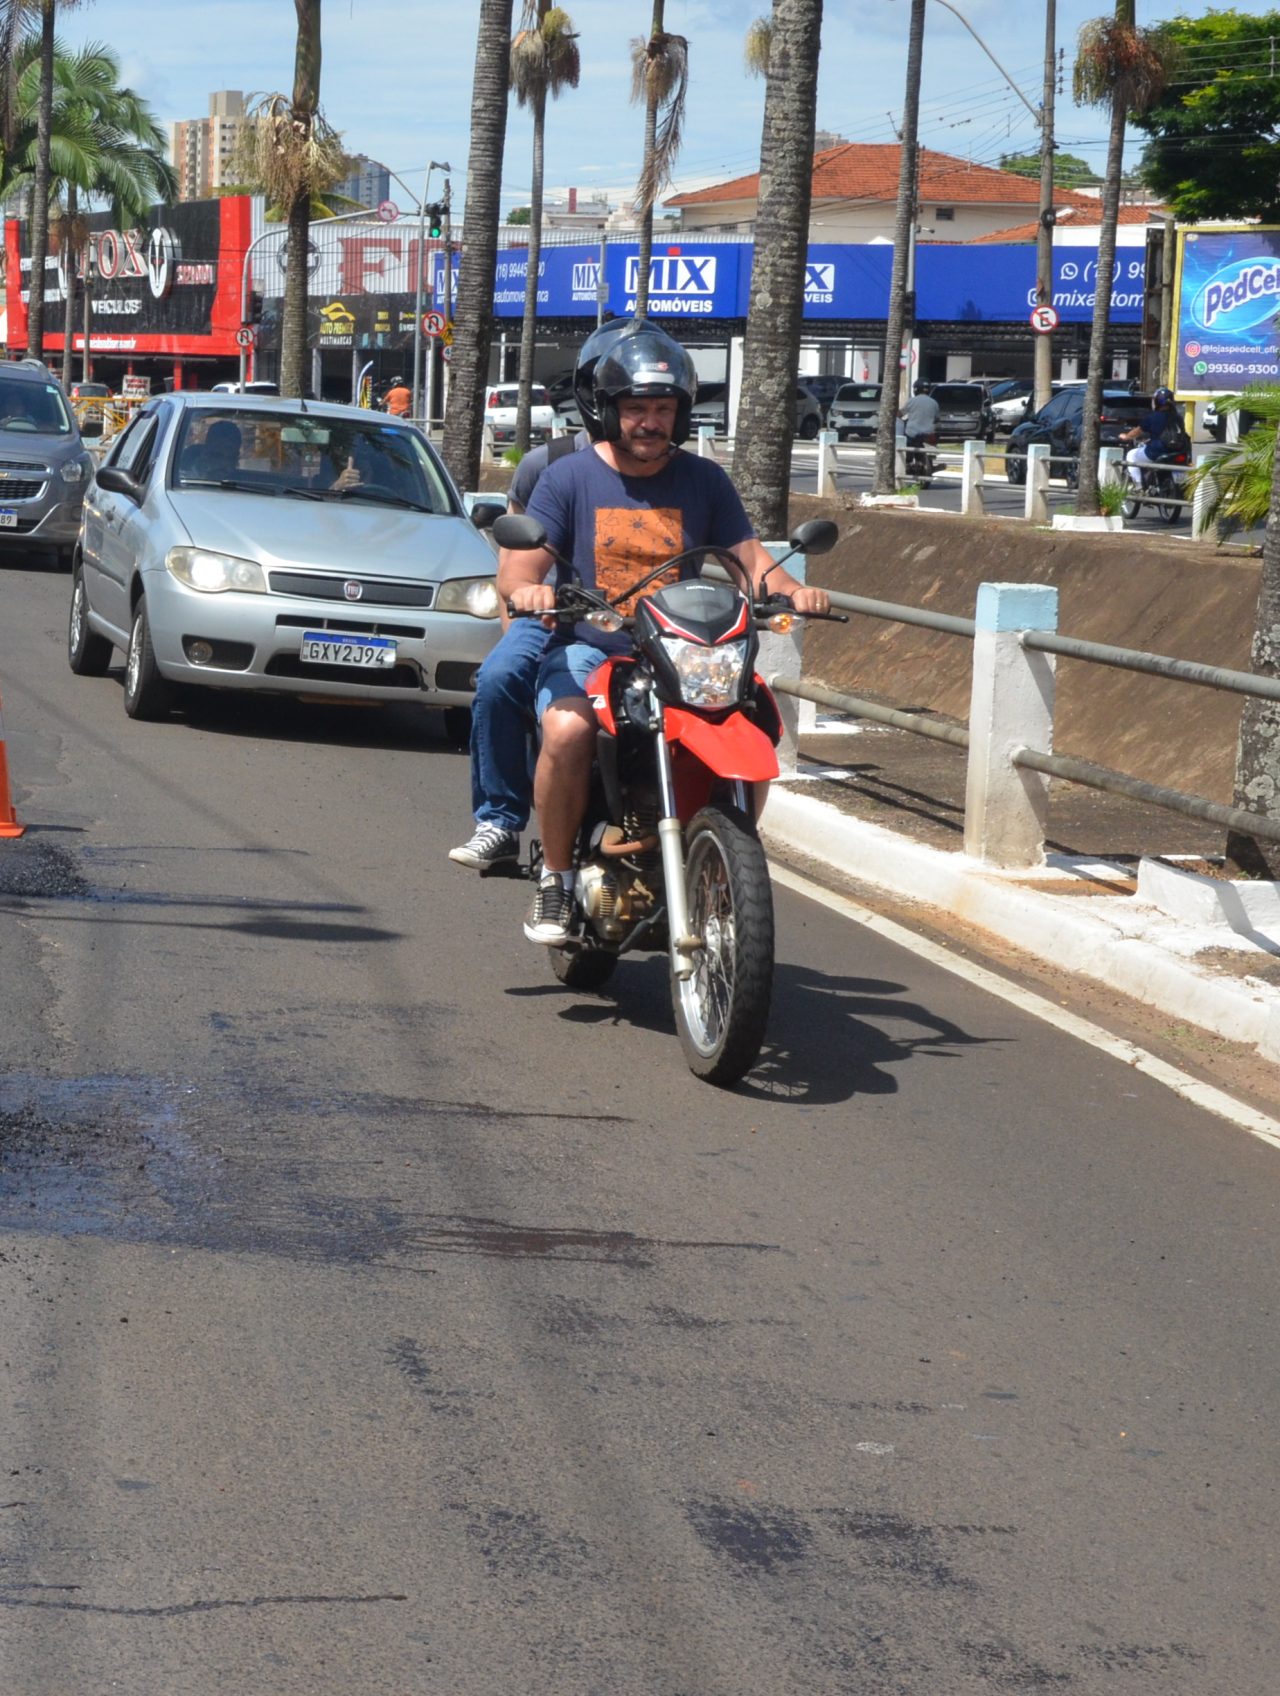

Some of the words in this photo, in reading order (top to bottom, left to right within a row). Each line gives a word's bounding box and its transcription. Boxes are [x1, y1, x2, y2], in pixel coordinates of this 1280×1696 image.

[629, 248, 712, 292] MIX
[91, 294, 143, 315] VEÍCULOS
[625, 297, 713, 313] ATOMÓVEIS
[1207, 363, 1278, 375] 99360-9300
[309, 642, 386, 665] GXY2J94
